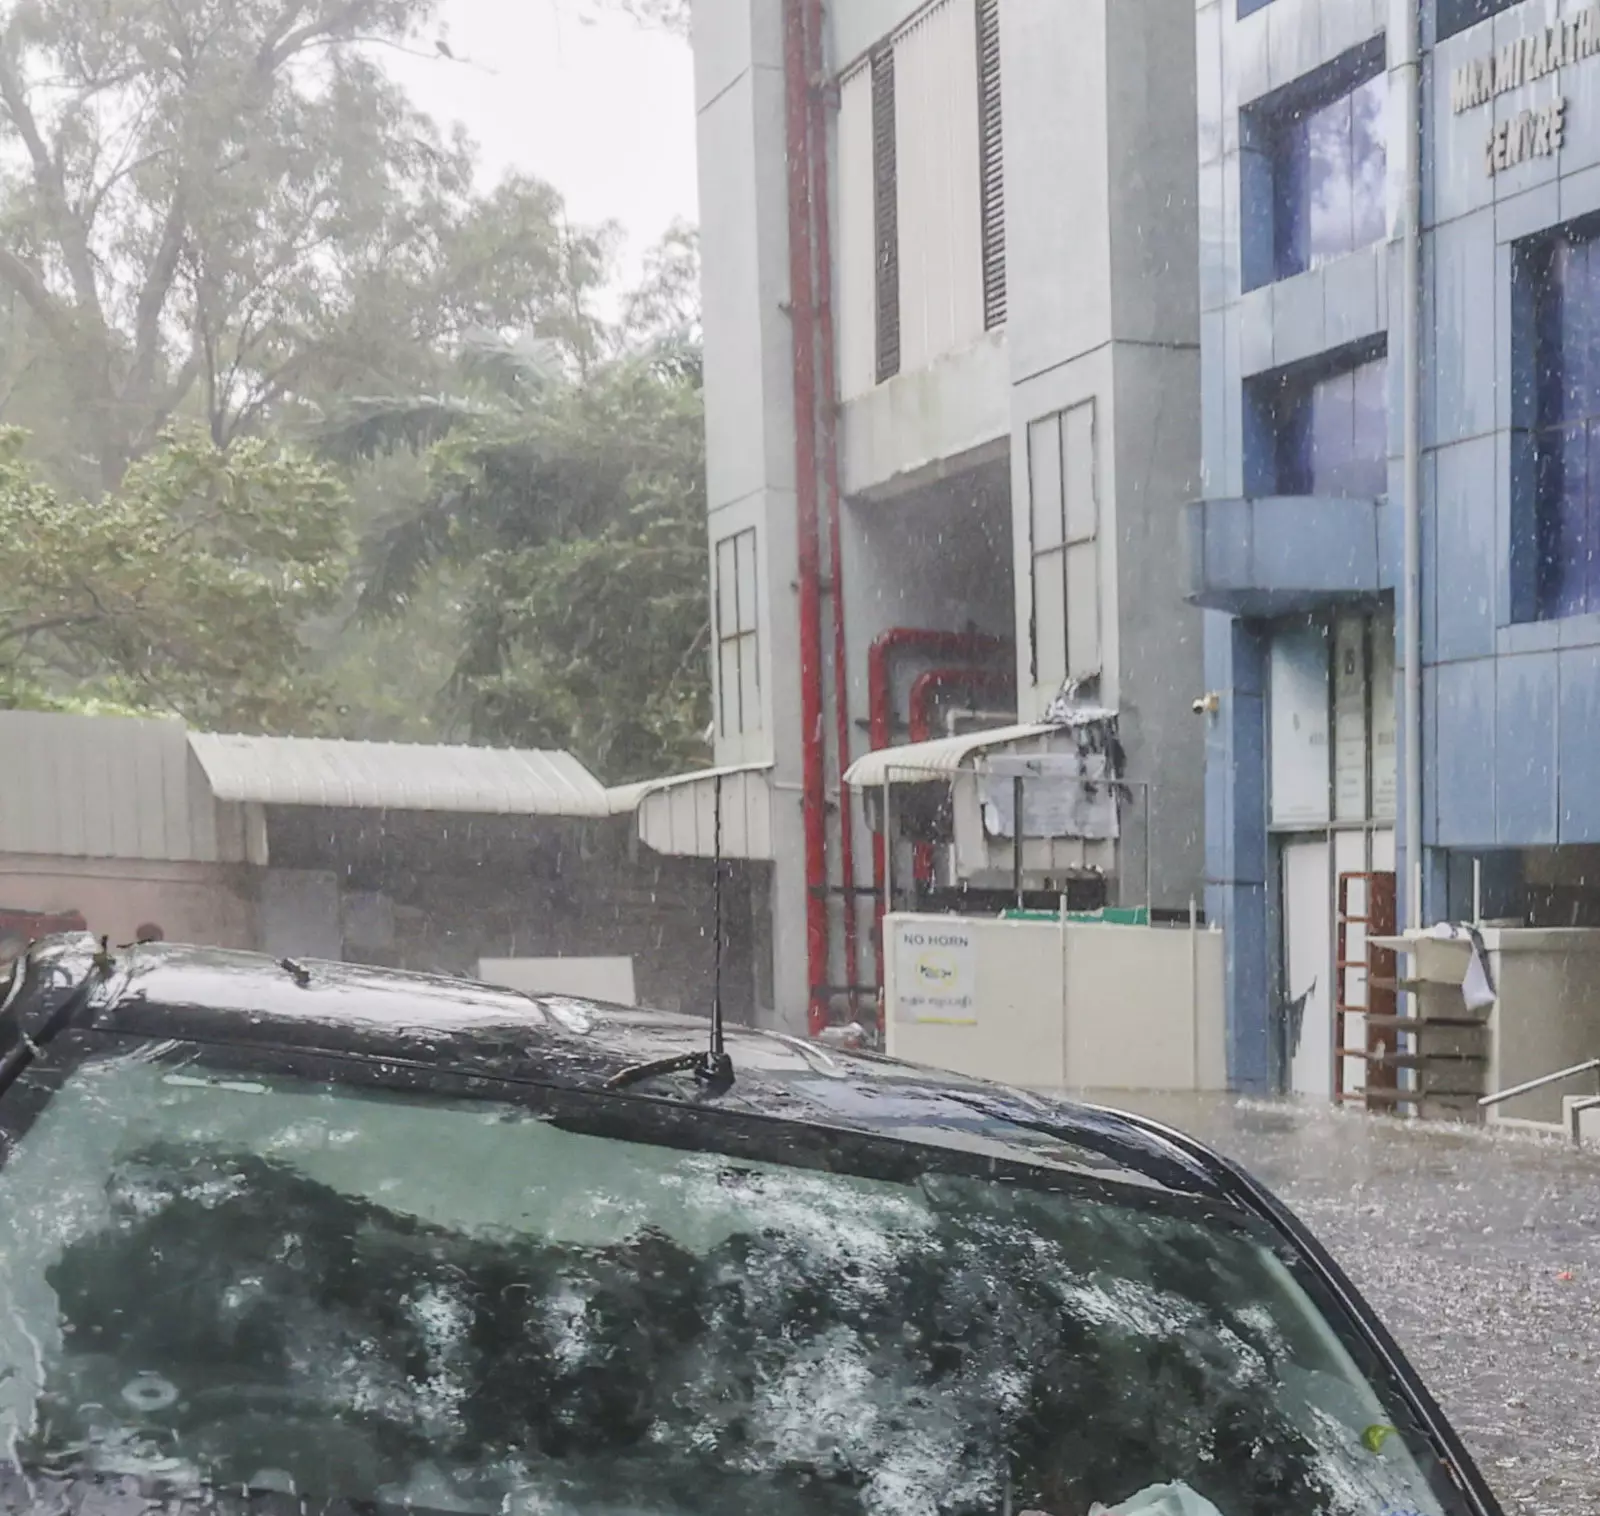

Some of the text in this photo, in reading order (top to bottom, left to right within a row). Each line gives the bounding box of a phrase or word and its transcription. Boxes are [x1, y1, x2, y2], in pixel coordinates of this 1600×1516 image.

[1486, 98, 1567, 178] CENTRE
[904, 933, 968, 948] NO HORN
